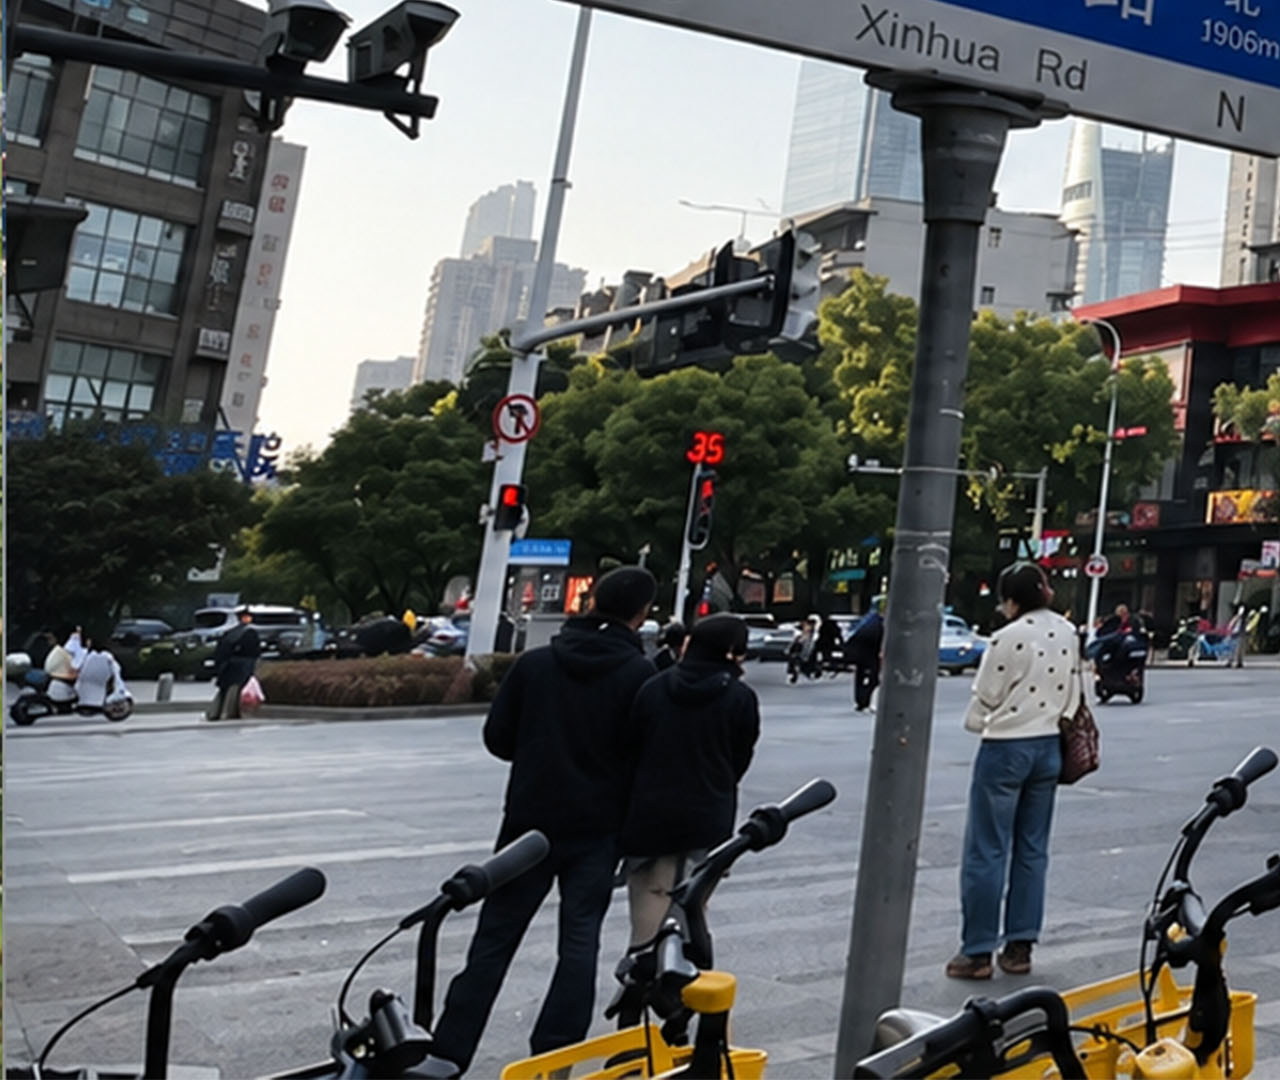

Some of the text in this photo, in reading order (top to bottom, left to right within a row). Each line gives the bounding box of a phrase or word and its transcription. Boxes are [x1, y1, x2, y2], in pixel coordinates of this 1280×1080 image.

[855, 3, 1089, 92] Xinhua Rd
[1200, 18, 1280, 60] 1906m
[1215, 90, 1247, 133] N
[686, 431, 725, 465] 35
